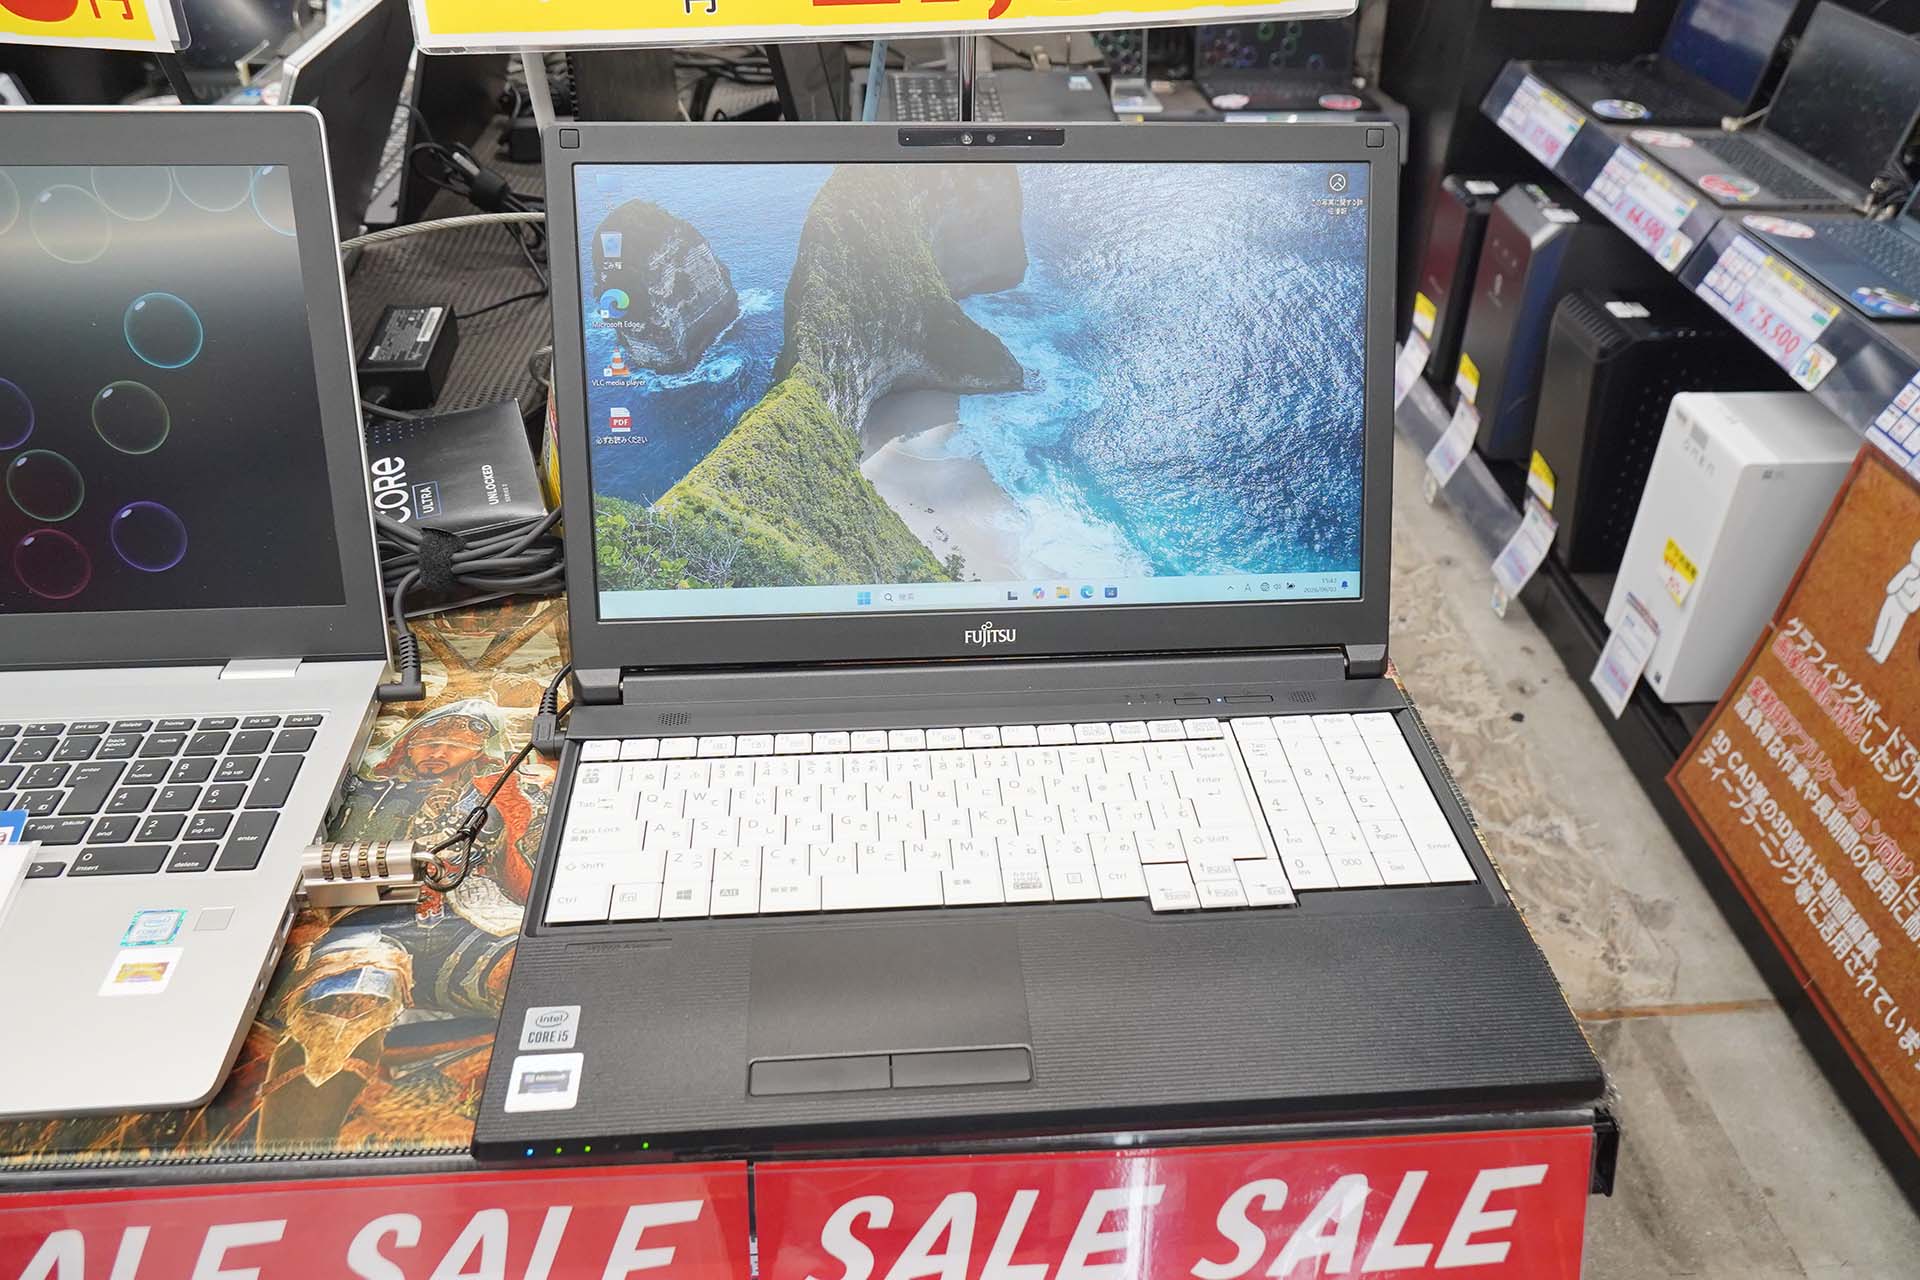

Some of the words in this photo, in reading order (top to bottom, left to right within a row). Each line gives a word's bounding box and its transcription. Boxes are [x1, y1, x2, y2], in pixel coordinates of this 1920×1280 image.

[624, 321, 641, 330] Edge
[626, 379, 647, 388] player
[481, 464, 500, 505] UNLOCKED
[422, 486, 434, 515] ULTRA
[964, 621, 1017, 647] FUJITSU
[1711, 729, 1732, 755] 3D
[120, 792, 128, 800] 4
[196, 818, 205, 826] 3
[82, 853, 93, 861] 0
[581, 862, 605, 870] Shift
[1698, 746, 1920, 1072] ディープラーニング等に活用されていま
[527, 1030, 557, 1044] CORE
[557, 1030, 569, 1043] i5
[805, 1185, 1165, 1280] SALE
[1191, 1165, 1548, 1280] SALE
